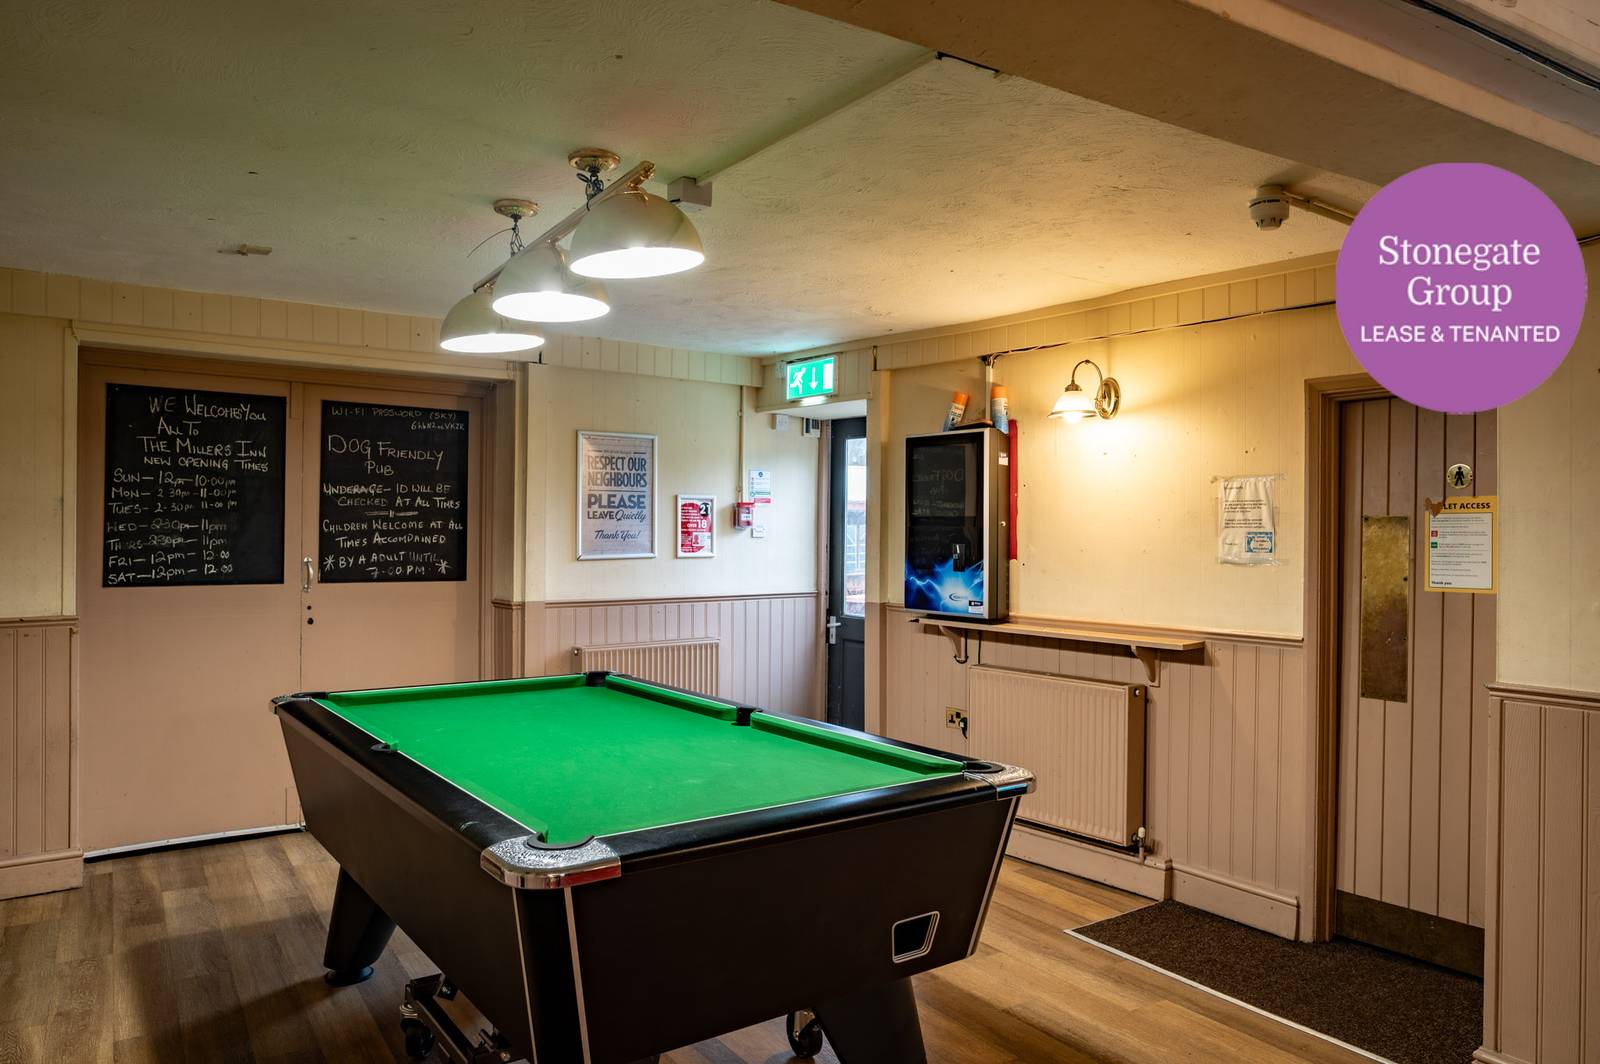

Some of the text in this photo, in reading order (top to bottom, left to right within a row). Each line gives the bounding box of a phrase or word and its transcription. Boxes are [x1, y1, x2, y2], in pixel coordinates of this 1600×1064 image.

[149, 396, 176, 413] WE
[371, 407, 423, 418] PASSWORD
[136, 435, 266, 458] THE MILLERS INN
[328, 434, 444, 470] DOG FRIENDLY
[144, 456, 269, 472] NEW OPENING TIMES
[365, 460, 394, 476] PUB
[587, 454, 647, 472] RESPECT OUR
[587, 471, 647, 488] NEIGHBOURS
[396, 483, 409, 494] ID
[411, 483, 433, 493] WILL
[436, 484, 451, 494] BE
[337, 497, 387, 507] CHECKED
[395, 496, 412, 507] AT
[432, 497, 461, 509] TIMES
[587, 493, 646, 509] PLEASE
[1459, 502, 1491, 510] ACCESS
[587, 509, 647, 523] LEAVE Quietly
[322, 519, 463, 534] CHILDREN WELCOME AT ALL
[697, 519, 708, 529] 18
[335, 536, 368, 549] TIMES
[594, 529, 640, 542] Thank You!
[358, 554, 367, 565] A
[371, 551, 407, 562] ADULT
[408, 552, 439, 563] UNTIL
